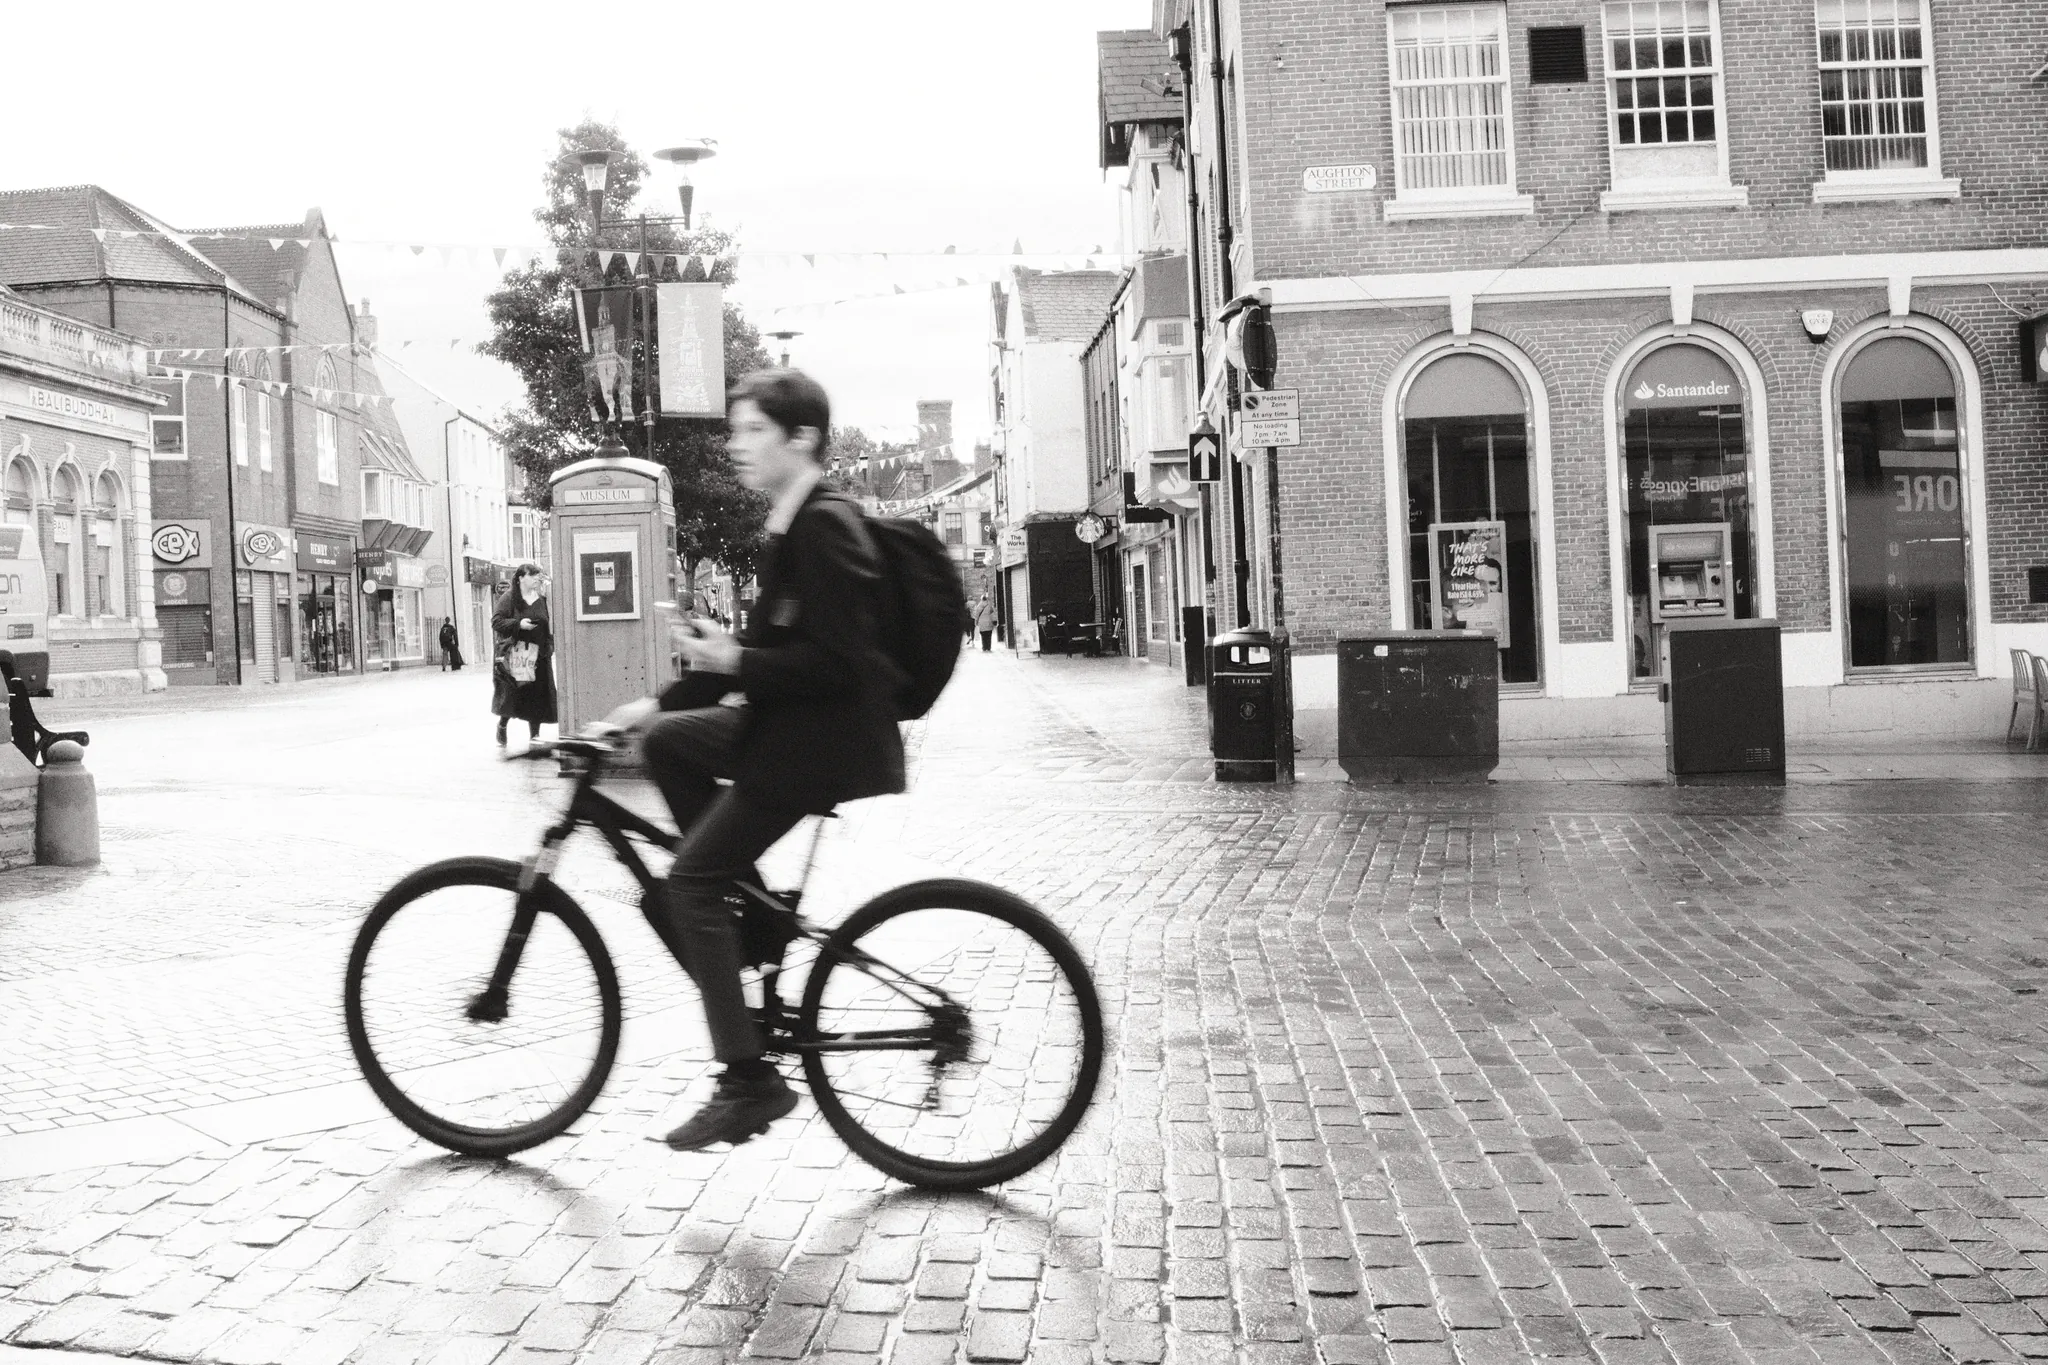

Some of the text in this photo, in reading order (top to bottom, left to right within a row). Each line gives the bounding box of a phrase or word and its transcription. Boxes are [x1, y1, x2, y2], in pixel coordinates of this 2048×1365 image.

[1308, 167, 1371, 178] AUGHTON
[1316, 178, 1363, 188] STREET
[1657, 380, 1730, 398] Santander
[580, 490, 630, 501] MUSEUM
[1449, 541, 1489, 553] THAT'S
[1454, 553, 1485, 565] MORE
[1450, 565, 1475, 577] LIKE
